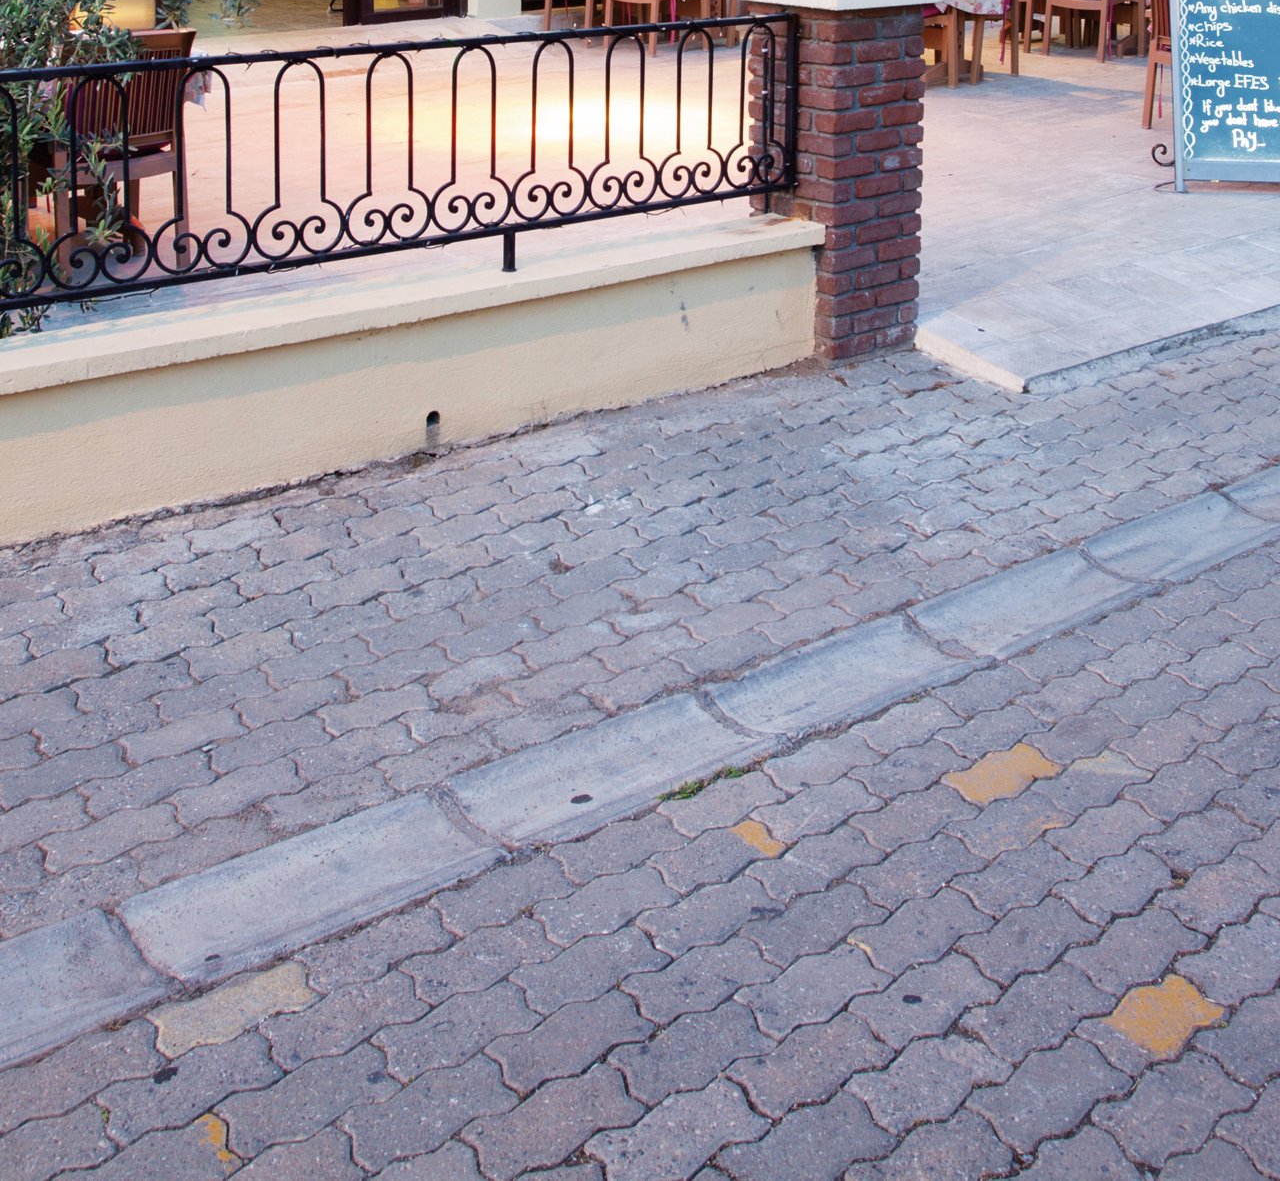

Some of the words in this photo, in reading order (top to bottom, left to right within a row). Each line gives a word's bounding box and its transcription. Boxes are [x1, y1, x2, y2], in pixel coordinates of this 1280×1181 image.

[1194, 1, 1218, 21] Any
[1220, 0, 1262, 14] chicken
[1196, 33, 1225, 47] Rice
[1195, 50, 1255, 73] Vegetables
[1197, 74, 1231, 98] Large
[1233, 73, 1270, 91] EFES
[1202, 99, 1213, 116] If
[1214, 102, 1233, 118] you
[1200, 118, 1220, 134] you
[1253, 113, 1280, 129] have
